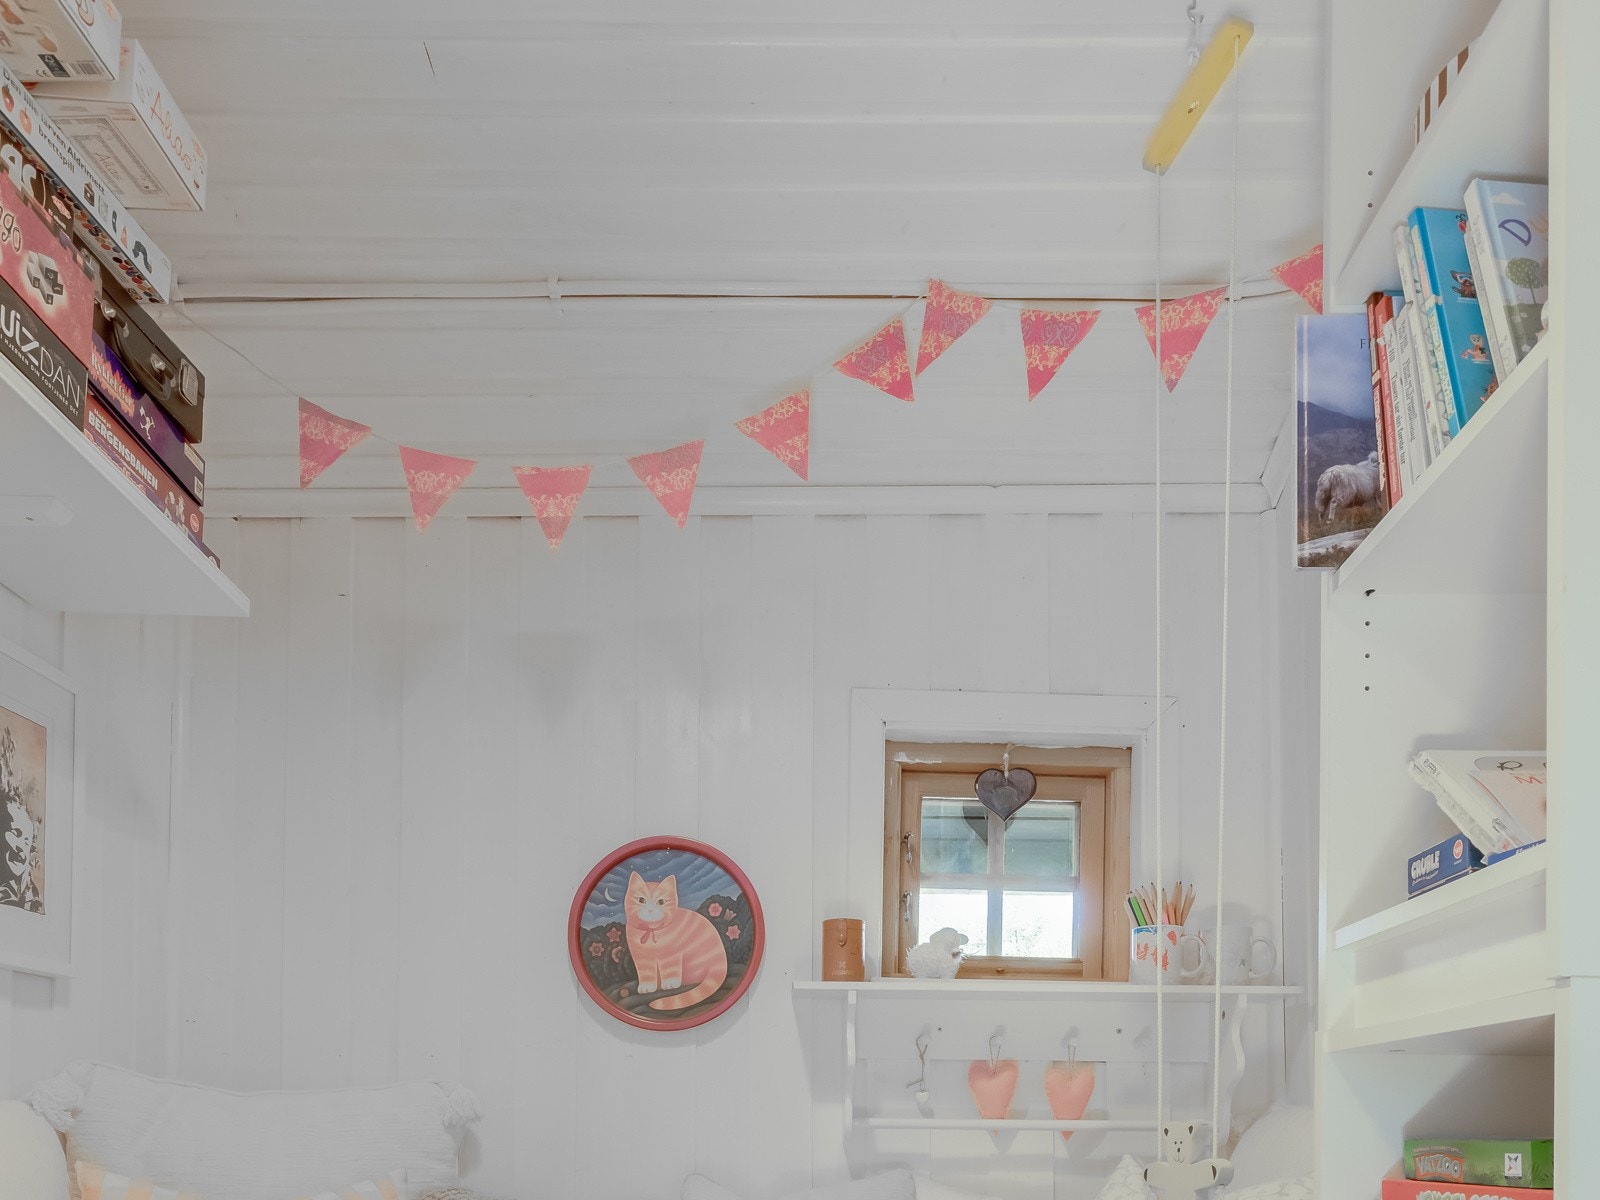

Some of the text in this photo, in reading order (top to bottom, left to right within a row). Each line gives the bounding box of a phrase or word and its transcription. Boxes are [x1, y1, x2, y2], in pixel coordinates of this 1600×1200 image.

[3, 68, 22, 95] Den
[67, 146, 105, 196] Aldrimett
[38, 124, 75, 173] brettspill
[4, 338, 29, 365] HJERNEN
[30, 364, 40, 377] DIN
[69, 405, 79, 417] DET
[88, 410, 158, 491] BERGENSBANEN
